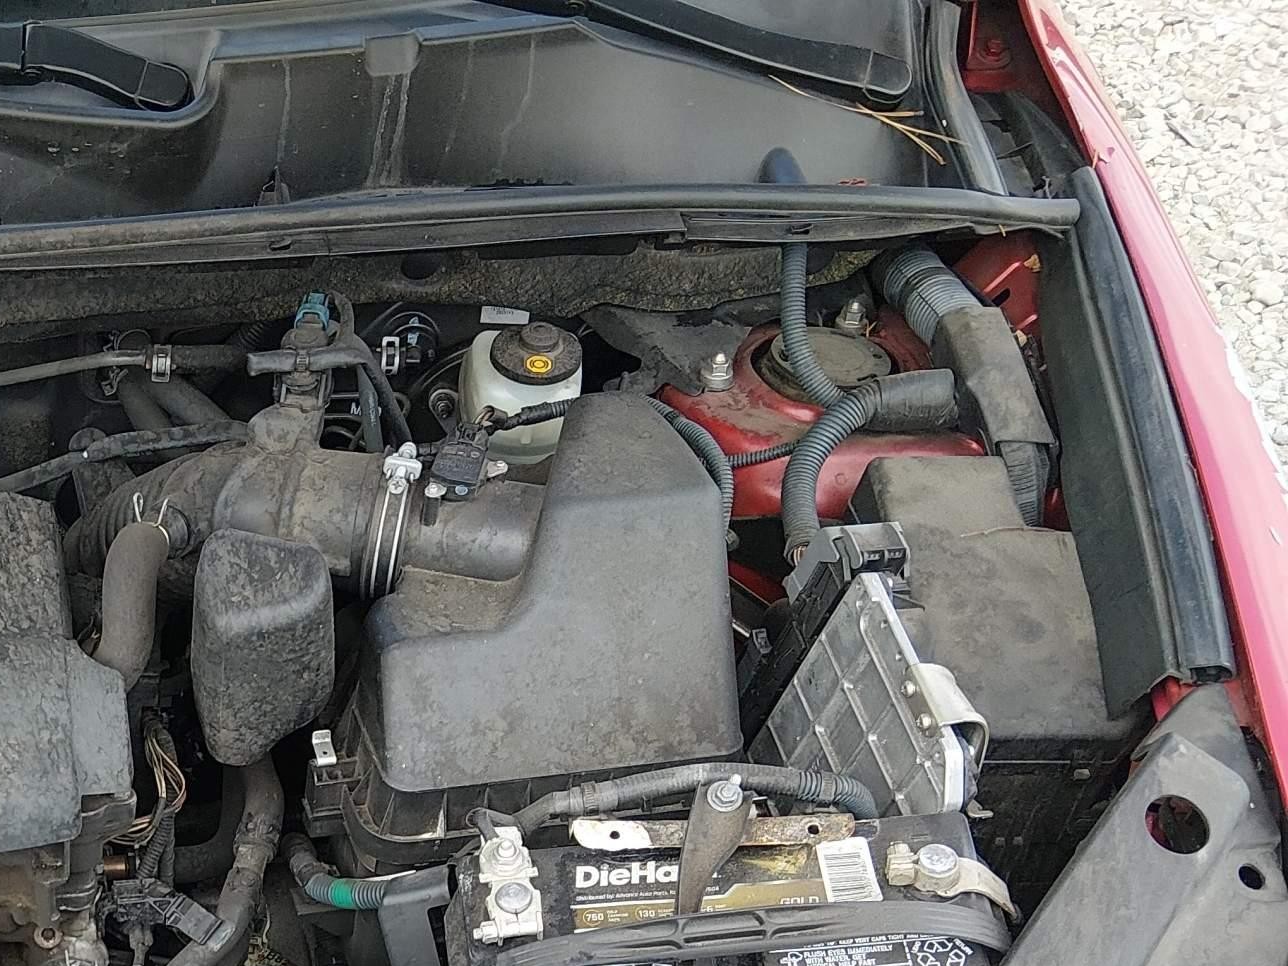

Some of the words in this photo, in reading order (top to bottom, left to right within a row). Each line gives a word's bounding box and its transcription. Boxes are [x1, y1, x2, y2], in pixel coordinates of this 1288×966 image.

[575, 861, 718, 888] DieHa
[586, 913, 604, 922] 750
[638, 909, 655, 919] 130
[804, 950, 826, 958] FLUSH
[858, 958, 876, 966] FAST
